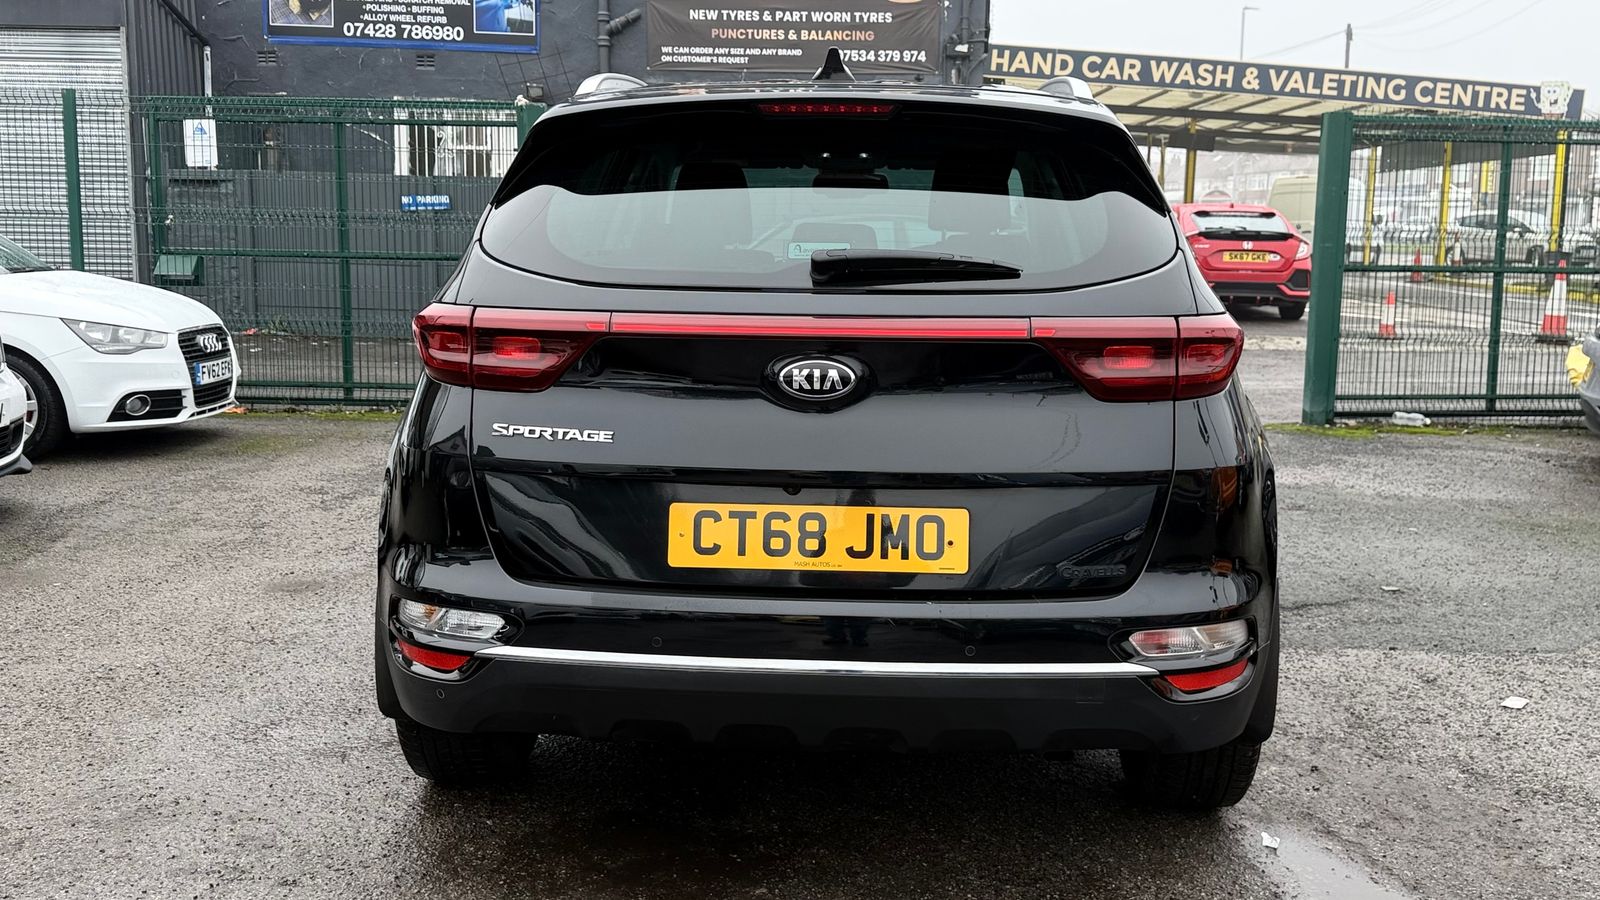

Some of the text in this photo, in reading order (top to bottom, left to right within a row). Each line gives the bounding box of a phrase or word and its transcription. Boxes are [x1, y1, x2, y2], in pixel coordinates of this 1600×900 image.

[366, 3, 445, 14] POLISHING BUFFING
[363, 13, 448, 24] ALLOY WHEEL REFURB
[689, 9, 893, 23] NEW TYRES & PART WORN TYRES
[343, 22, 465, 41] 07428 786980
[711, 28, 875, 41] PUNCTURES & BALANCING
[661, 46, 673, 54] WE
[690, 47, 714, 55] ORDER
[714, 47, 730, 55] ANY
[761, 48, 777, 56] ANY
[778, 48, 803, 56] BRAND
[878, 50, 901, 62] 379
[903, 50, 927, 62] 974
[673, 55, 718, 63] CUSTOMER'S
[718, 56, 749, 64] REQUEST
[990, 48, 1527, 111] HAND CAR WASH & VALETING CENTRE
[401, 195, 450, 204] NO PARKING
[201, 362, 221, 380] FV62
[791, 368, 843, 390] KIA
[491, 422, 615, 443] SPORTAGE
[693, 509, 946, 561] CT68 JMO
